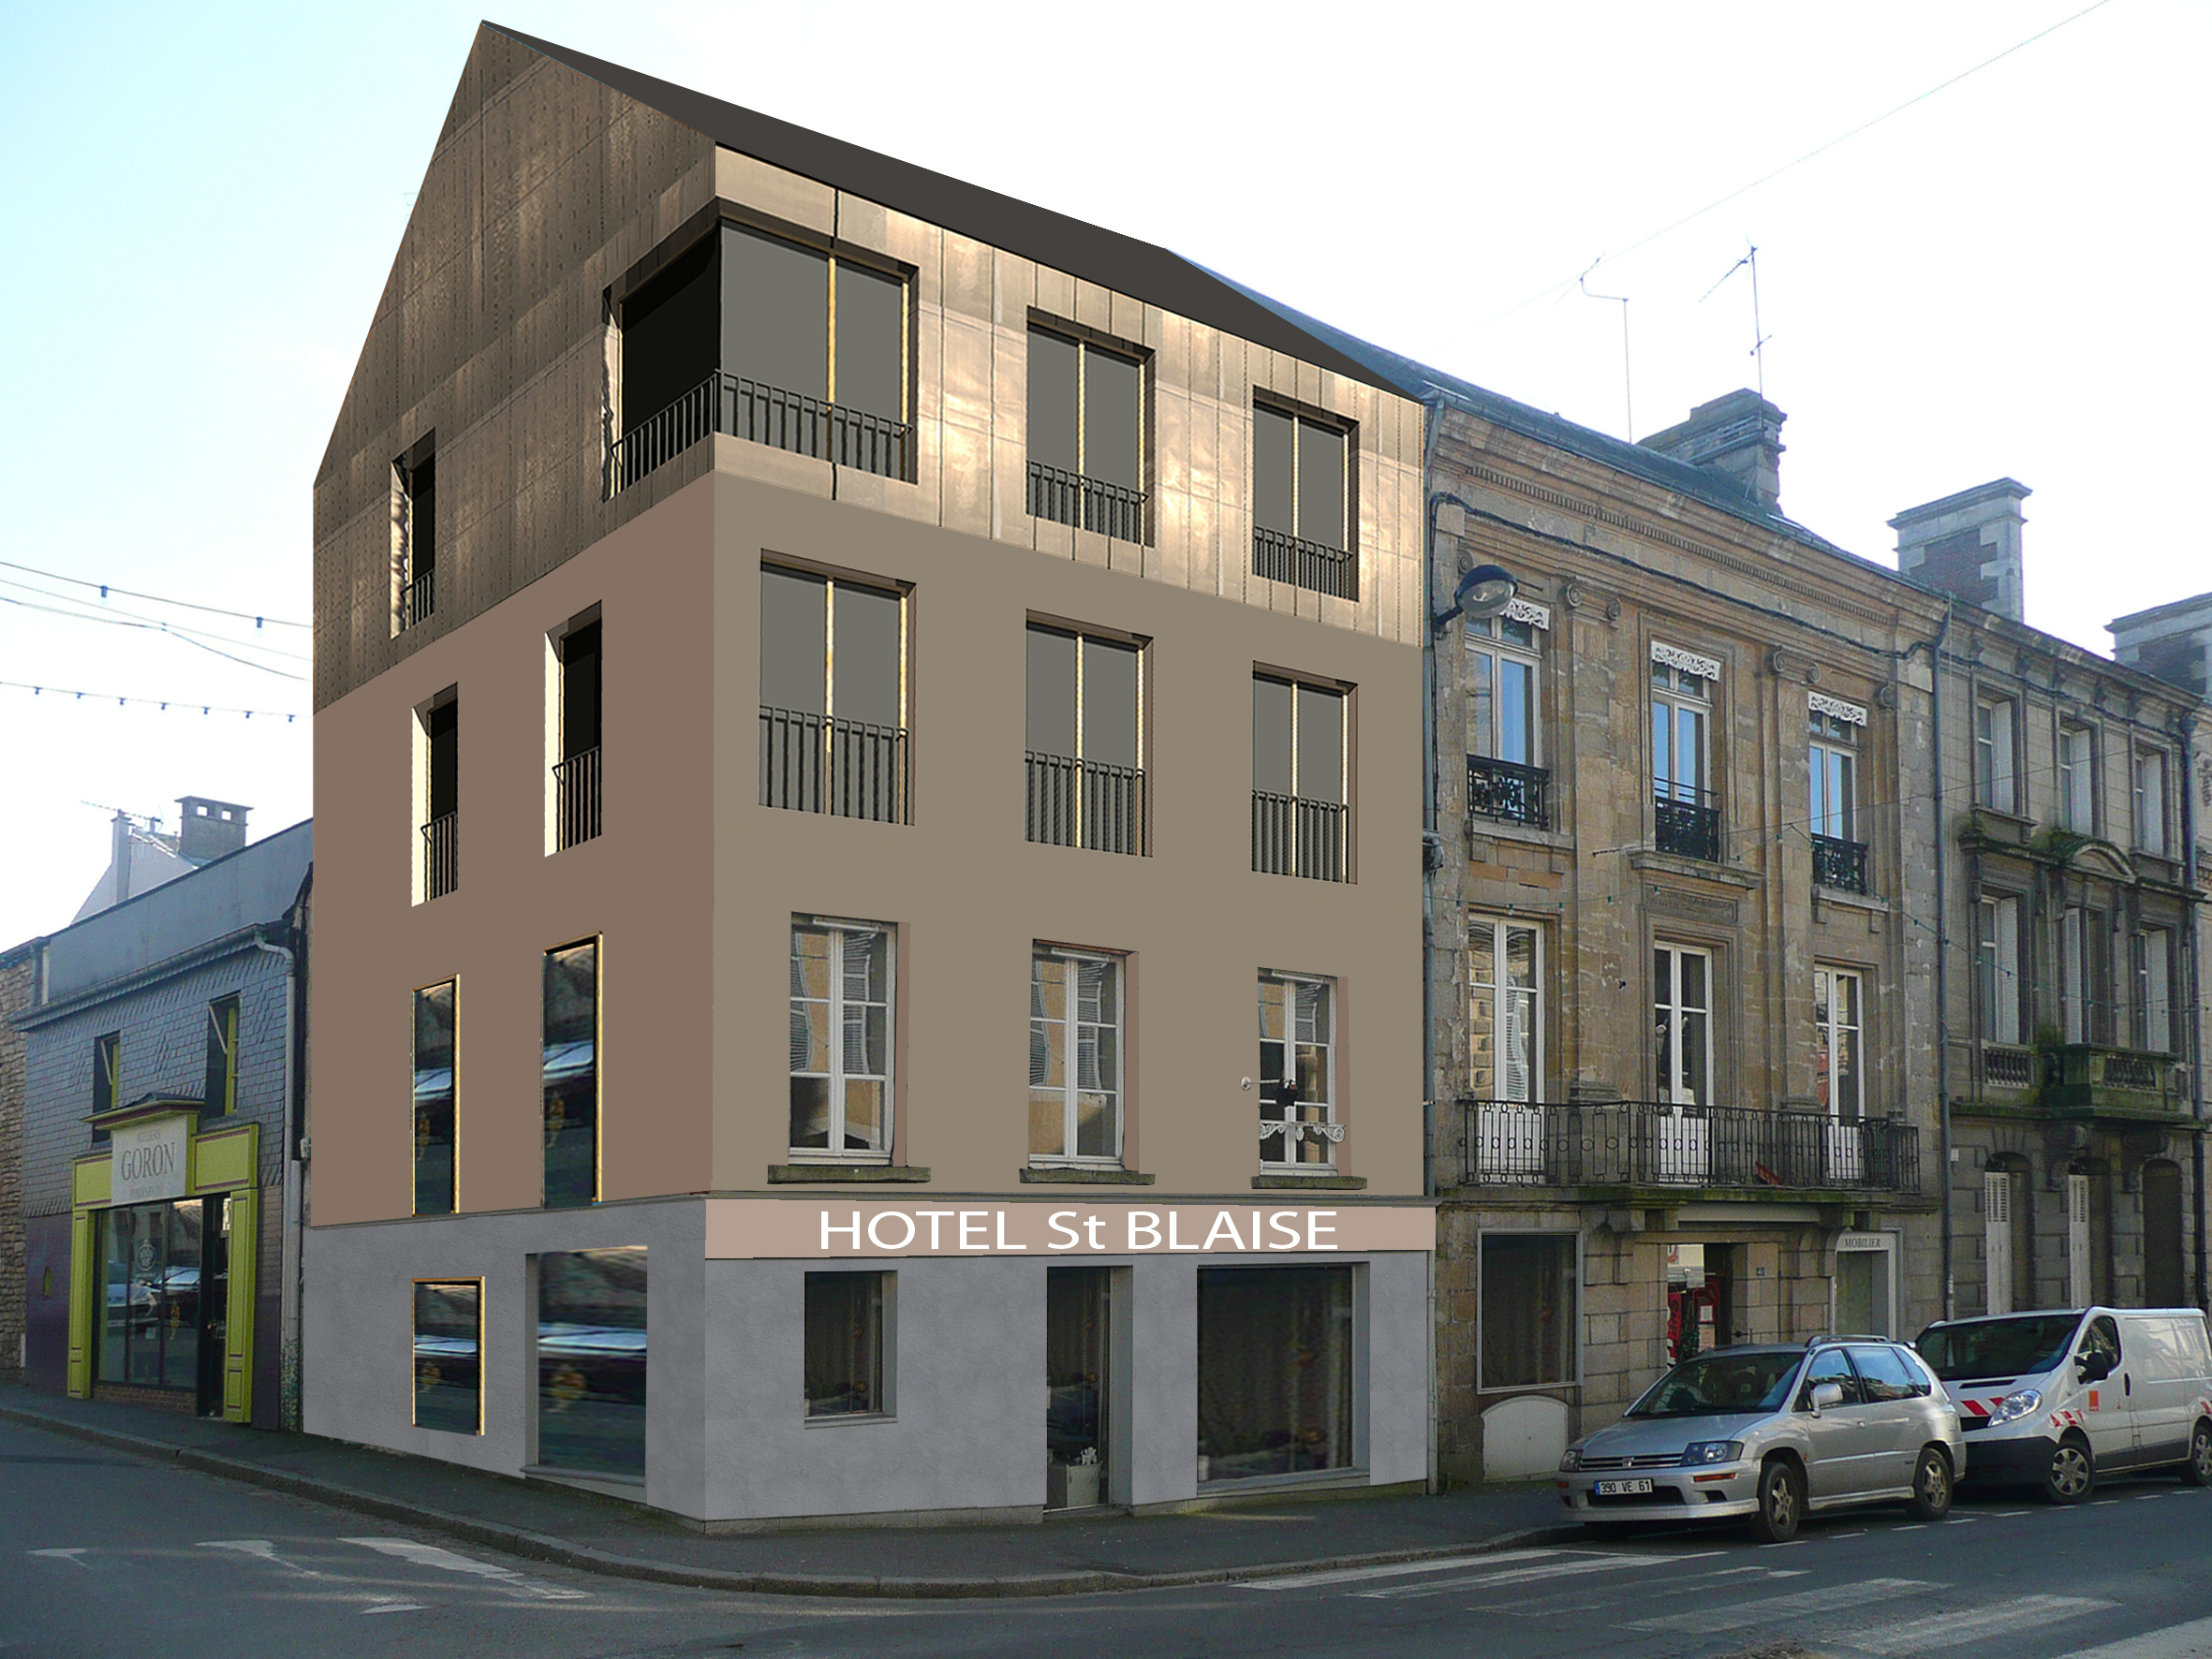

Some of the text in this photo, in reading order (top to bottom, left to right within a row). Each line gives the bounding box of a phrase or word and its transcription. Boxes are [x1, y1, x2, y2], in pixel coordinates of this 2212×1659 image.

[122, 1141, 175, 1181] GORON
[820, 1211, 1338, 1250] HOTEL St BLAISE
[1845, 1238, 1881, 1248] MOBILIER
[1600, 1480, 1650, 1493] 390 VE 61
